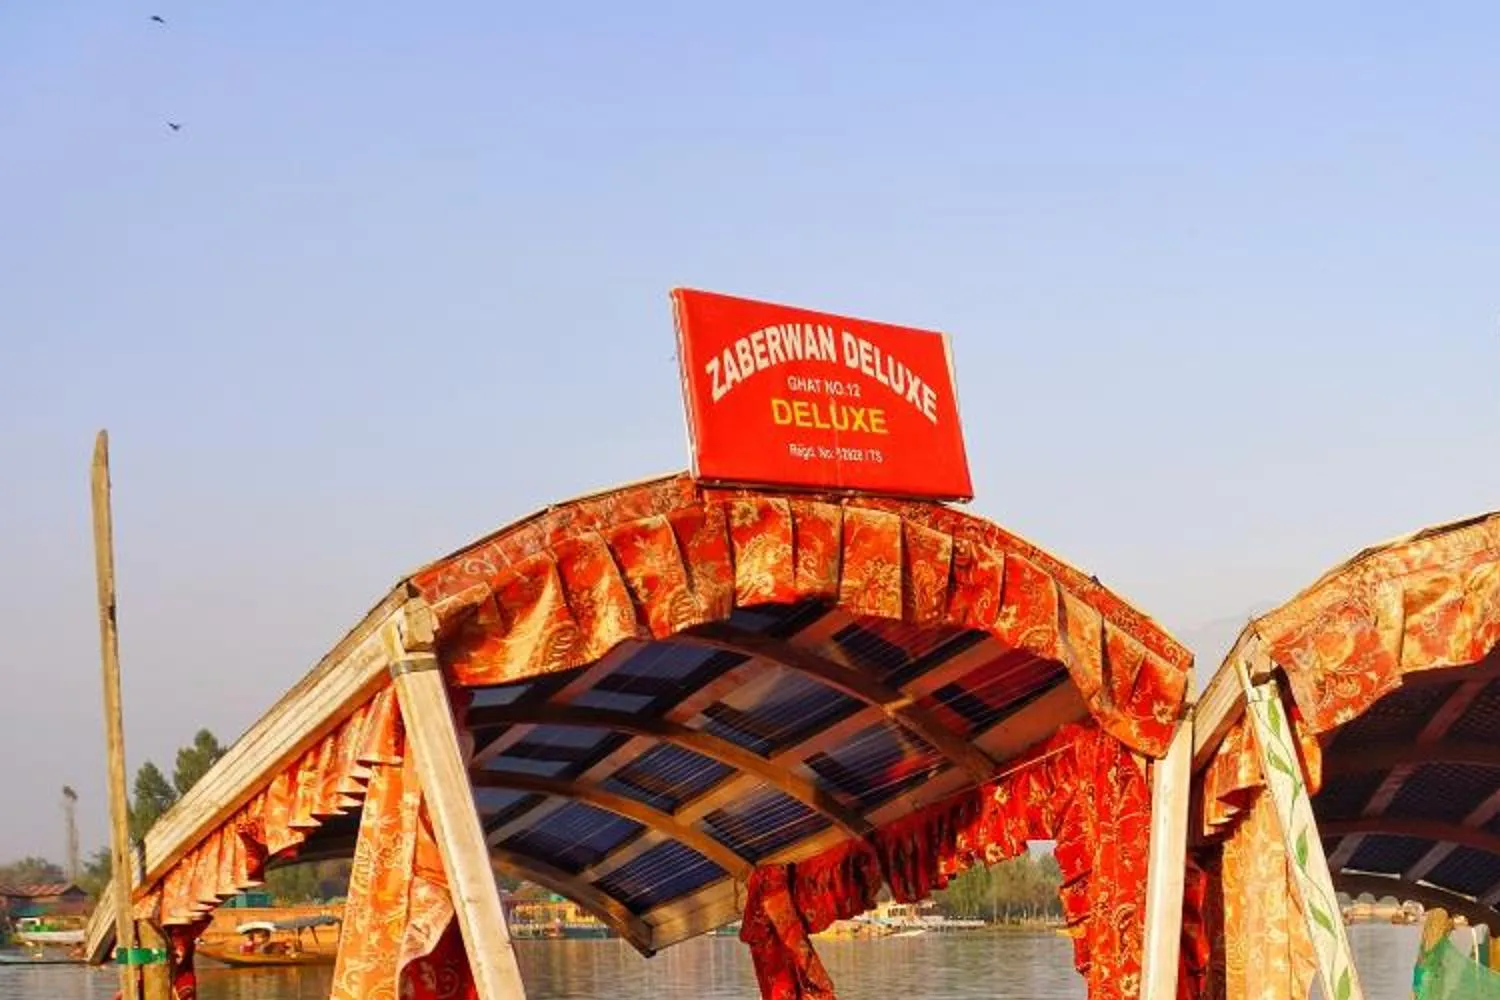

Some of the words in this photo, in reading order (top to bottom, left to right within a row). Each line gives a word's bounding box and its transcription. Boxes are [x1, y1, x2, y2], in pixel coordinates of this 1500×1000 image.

[705, 323, 837, 401] ZABERWAN
[841, 331, 938, 425] DELUXE
[787, 375, 820, 393] GHAT
[771, 397, 889, 433] DELUXE
